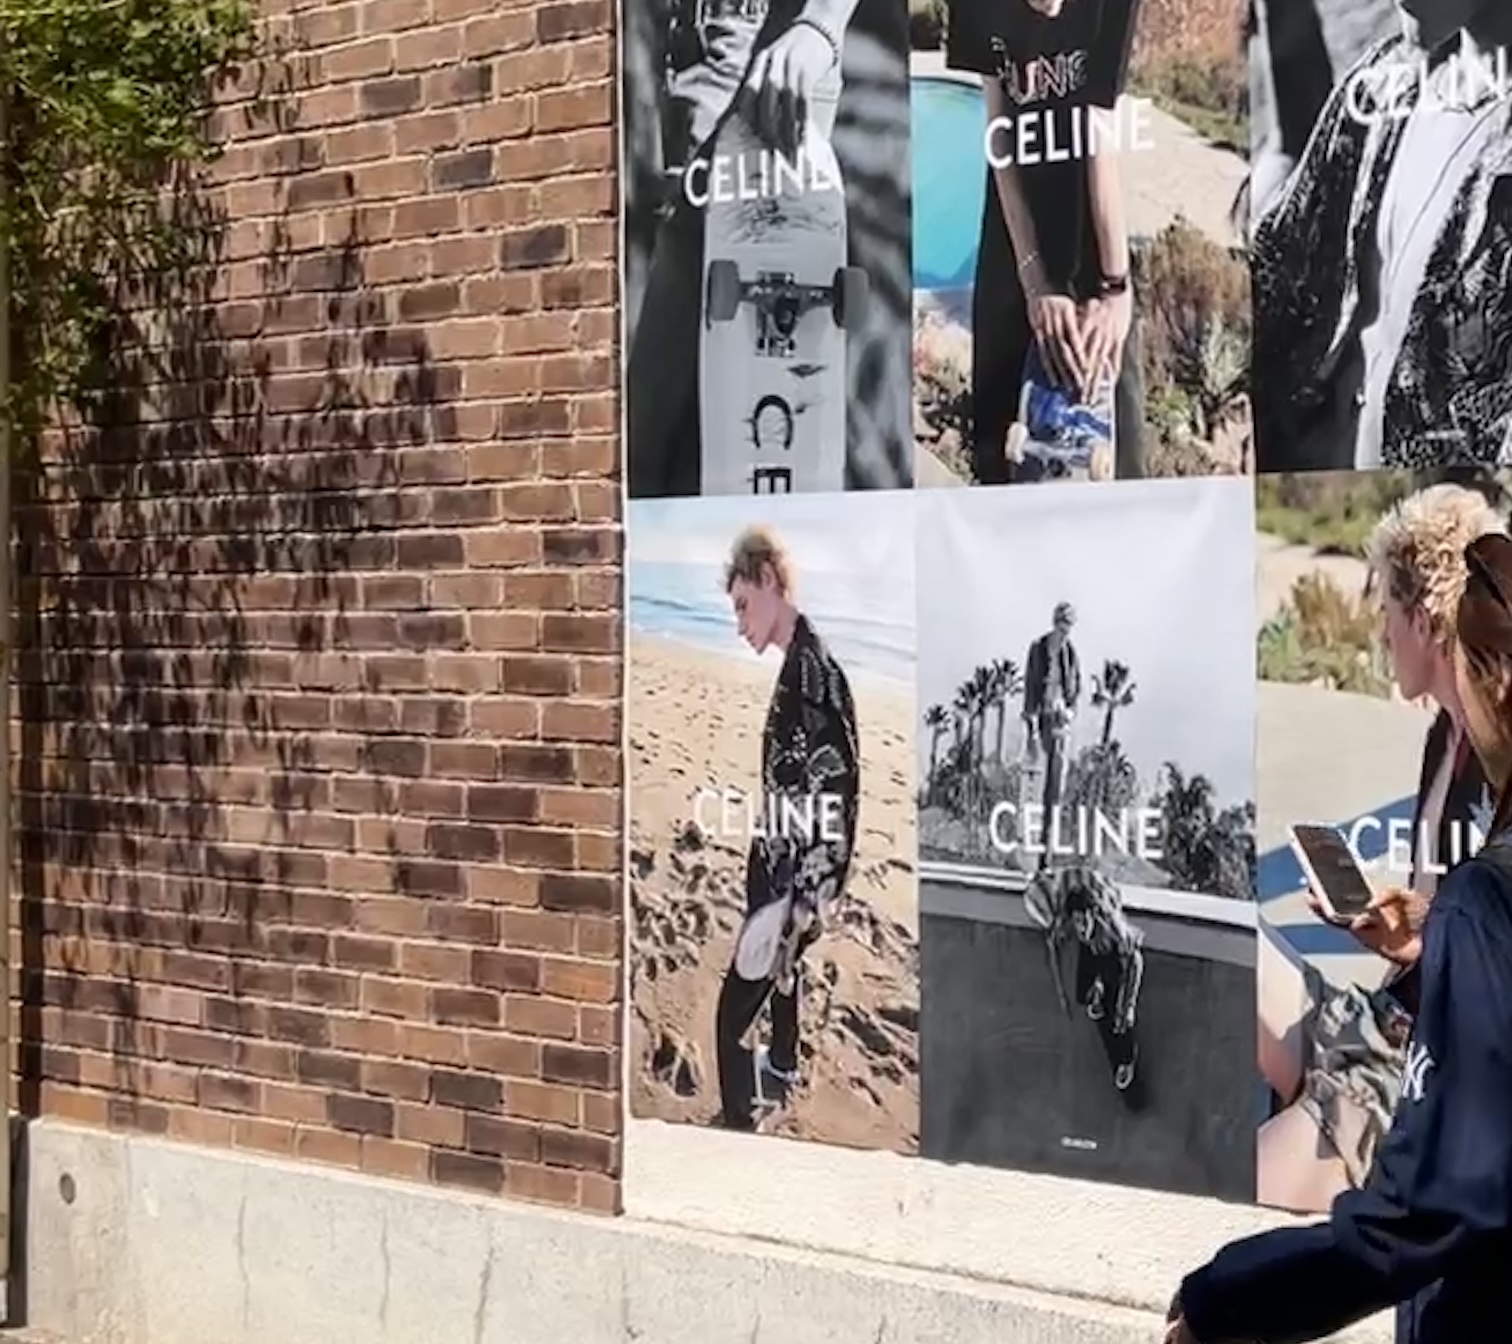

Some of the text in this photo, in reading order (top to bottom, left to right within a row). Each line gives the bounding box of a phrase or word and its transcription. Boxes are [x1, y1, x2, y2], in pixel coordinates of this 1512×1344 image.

[984, 93, 1155, 169] CELINE
[684, 144, 837, 207] CELINE
[694, 787, 845, 846] CELINE
[988, 801, 1165, 861] CELINE
